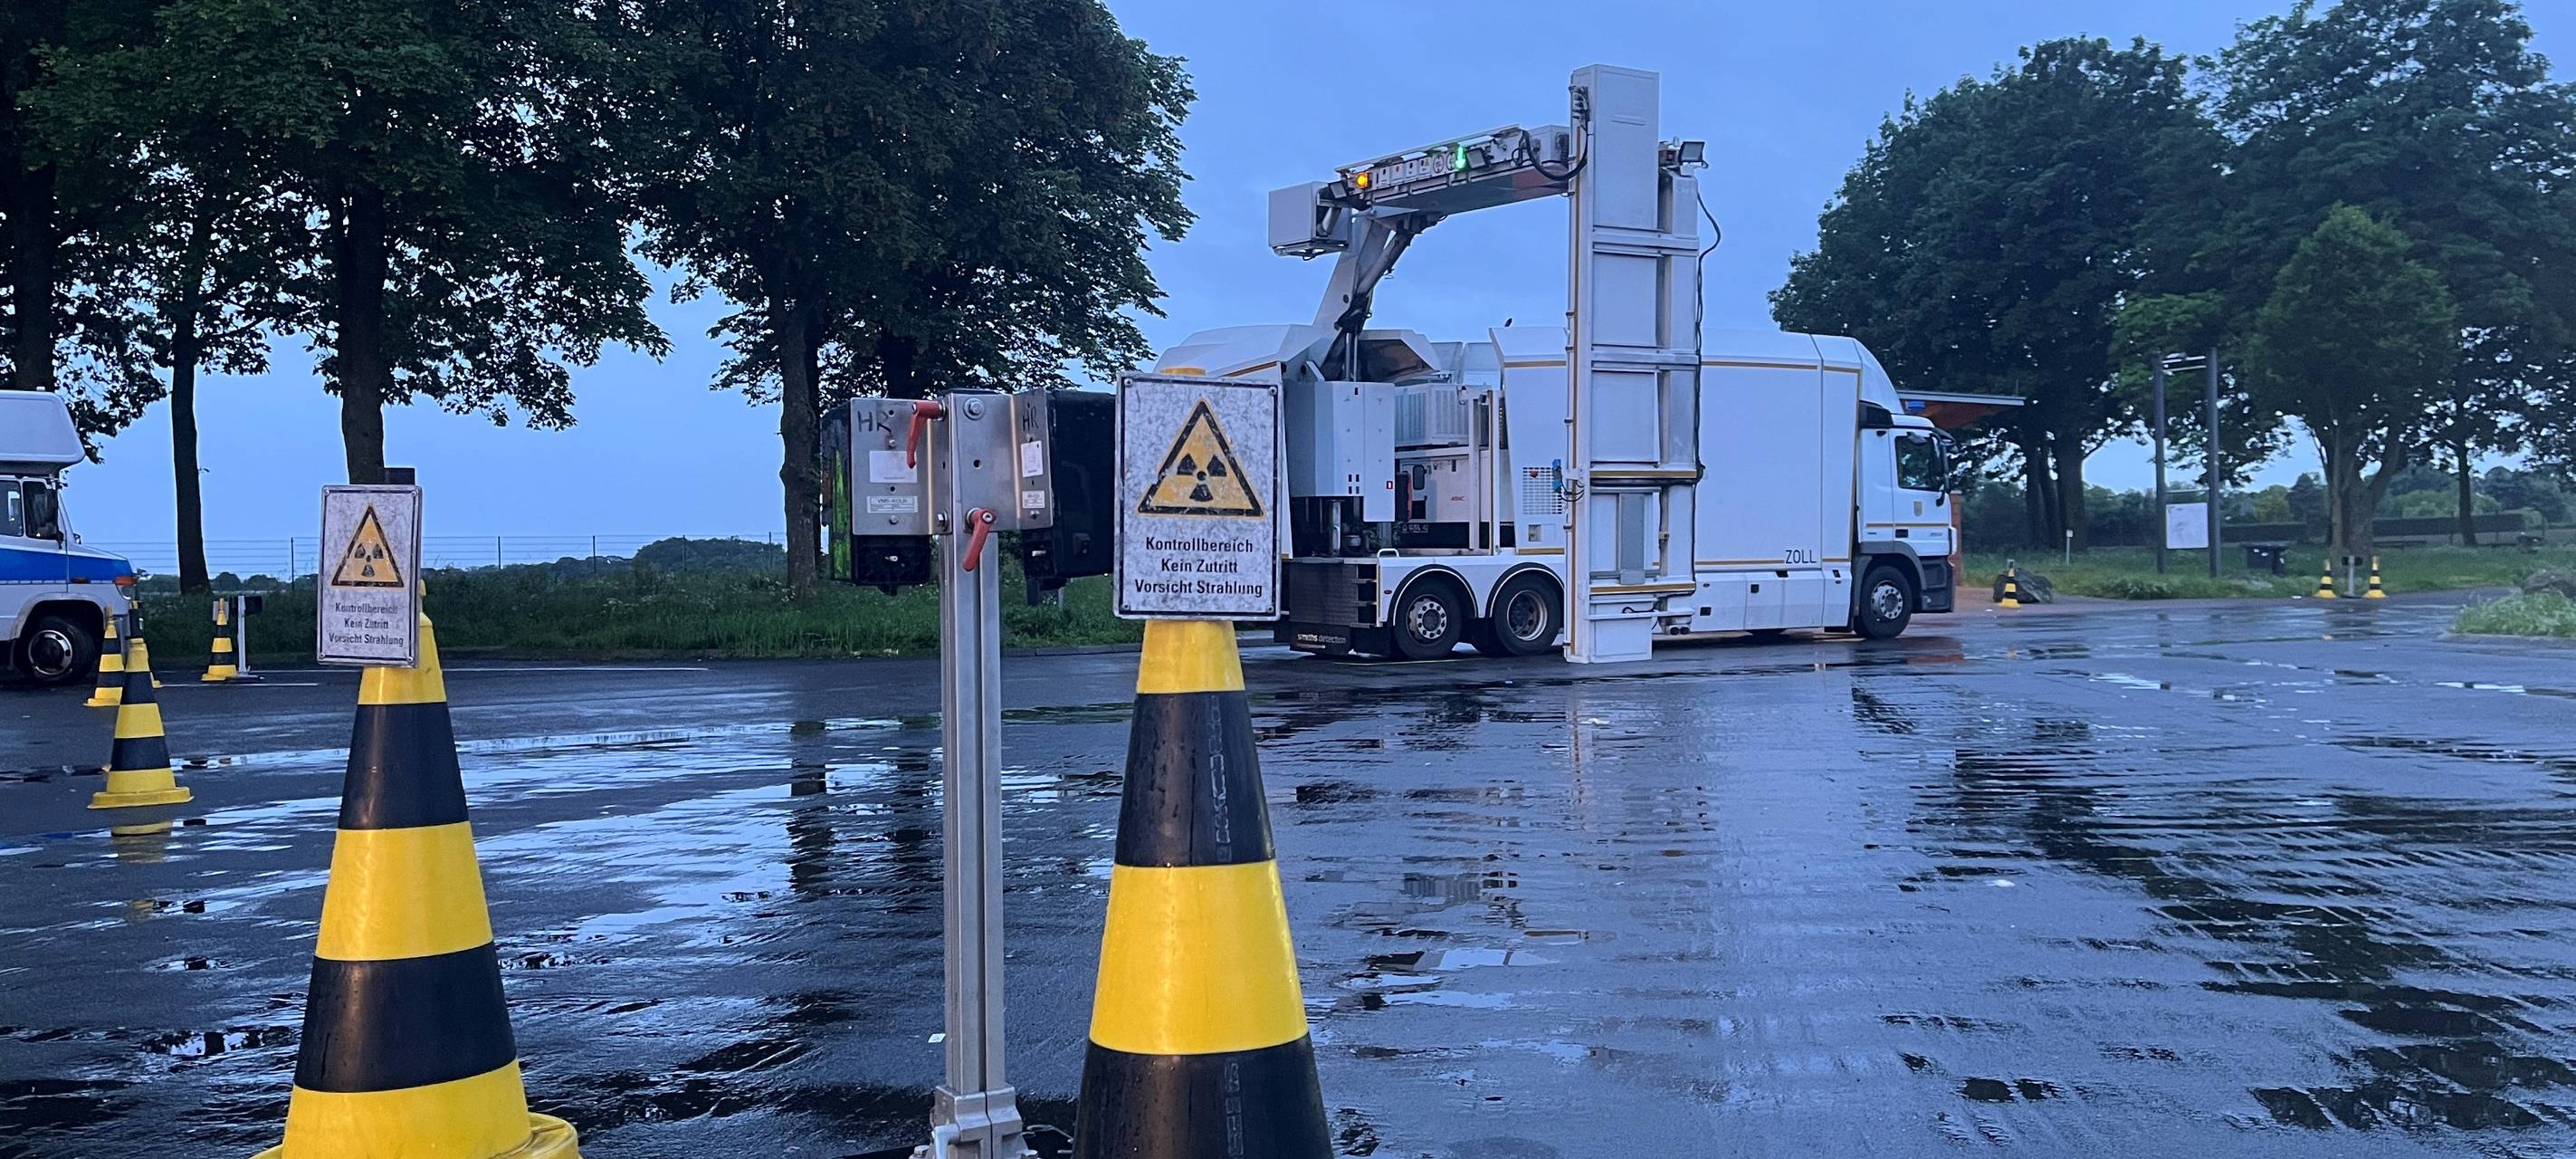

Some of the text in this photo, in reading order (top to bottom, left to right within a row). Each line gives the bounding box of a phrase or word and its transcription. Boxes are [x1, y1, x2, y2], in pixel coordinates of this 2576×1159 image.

[1145, 536, 1254, 553] Kontrollbereich
[1785, 549, 1818, 564] ZOLL
[1161, 559, 1238, 574] Kein Zutritt
[1134, 580, 1263, 598] Vorsicht Strahlung
[344, 618, 362, 628] Kein
[329, 632, 404, 647] Vorsicht Strahlung
